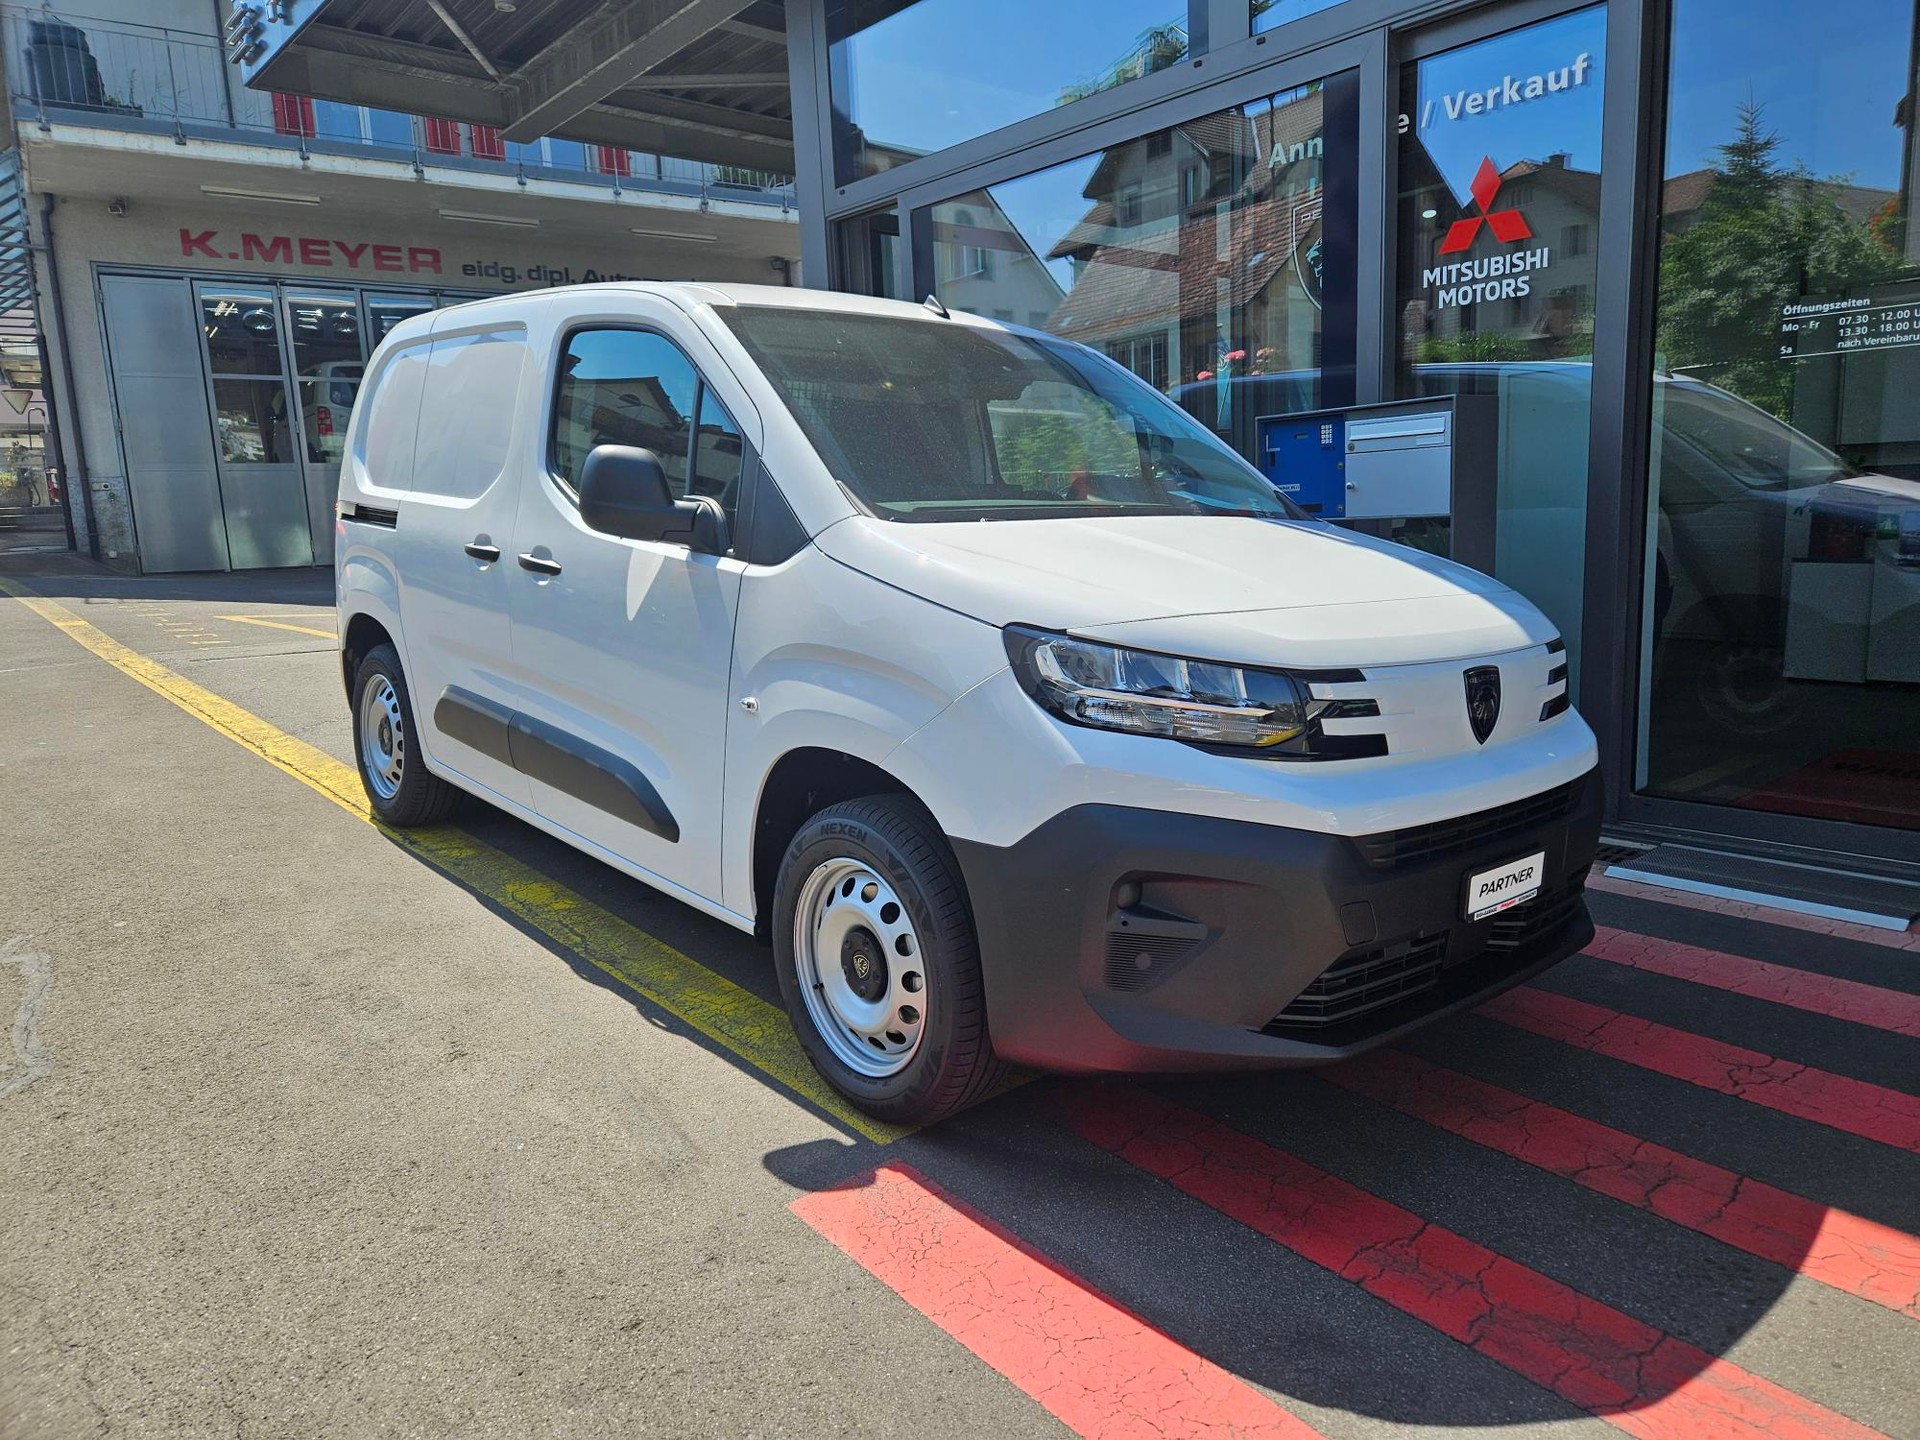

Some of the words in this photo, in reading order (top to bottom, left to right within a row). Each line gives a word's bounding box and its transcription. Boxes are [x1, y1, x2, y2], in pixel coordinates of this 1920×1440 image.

[1444, 52, 1589, 121] Verkauf
[462, 260, 522, 284] eidg.
[1422, 247, 1549, 289] MITSUBISHI
[1438, 275, 1530, 309] MOTORS
[1782, 298, 1870, 316] Öffnungszeiten
[1782, 323, 1799, 332] Mo
[1809, 320, 1820, 330] Fr
[1838, 314, 1869, 326] 07.30
[1881, 309, 1911, 321] 12.00
[1838, 326, 1868, 337] 13.30
[1880, 321, 1910, 333] 18.00
[1780, 345, 1793, 354] Sa
[1837, 337, 1862, 349] nach
[820, 823, 868, 842] NEXEN
[1478, 866, 1535, 898] PARTNER
